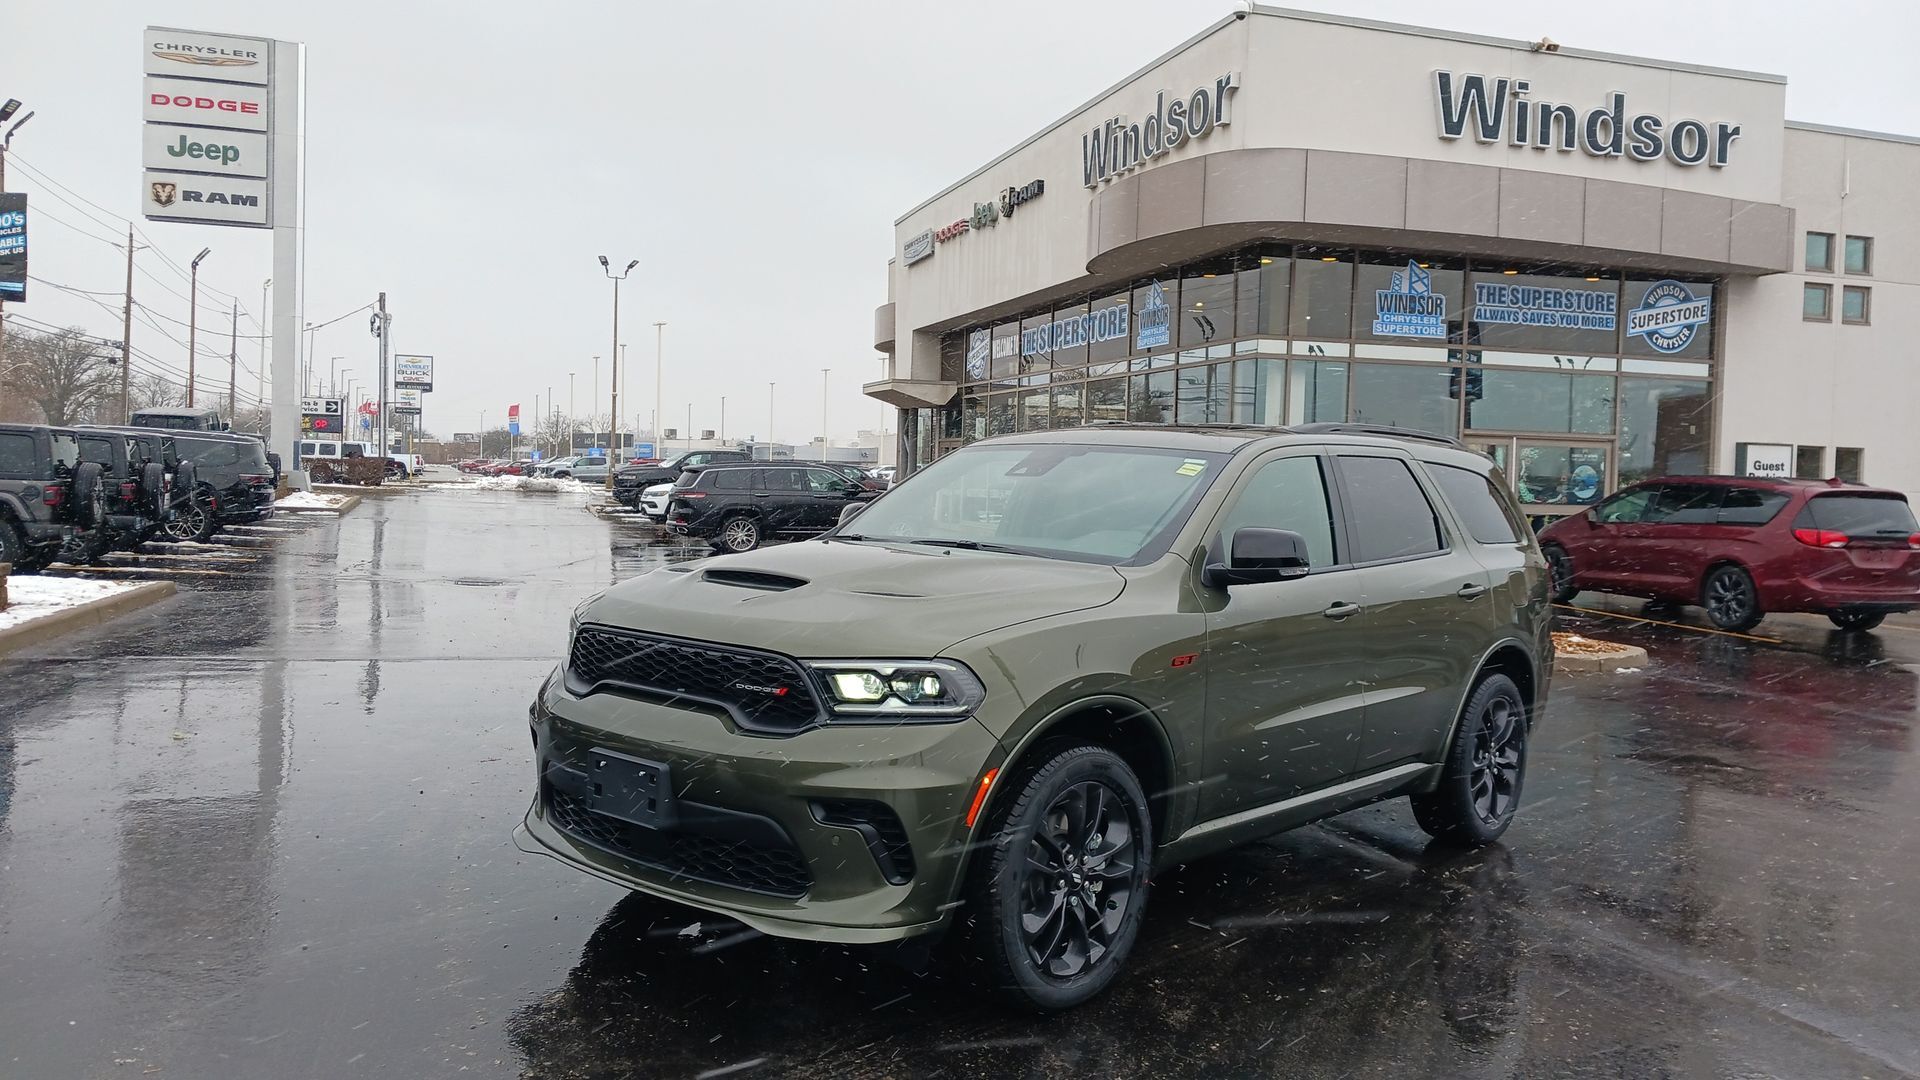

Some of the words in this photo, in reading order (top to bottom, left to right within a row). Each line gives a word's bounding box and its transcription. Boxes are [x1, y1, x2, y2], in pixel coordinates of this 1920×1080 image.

[153, 42, 258, 59] CHRYSLER
[151, 94, 259, 115] DODGE
[1431, 69, 1742, 168] Windsor
[1082, 72, 1240, 189] Windsor
[167, 134, 240, 166] Jeep
[182, 190, 258, 207] RAM
[1011, 180, 1045, 206] RAM
[970, 202, 1000, 230] Jeep
[903, 232, 930, 251] CHRYSLER
[935, 218, 970, 244] DODGE
[1377, 291, 1444, 316] WINDSOR
[1476, 285, 1507, 304] THE
[1509, 287, 1615, 313] SUPERSTORE
[1649, 285, 1686, 305] WINDSOR
[1383, 314, 1437, 325] CHRYSLER
[1475, 308, 1520, 323] ALWAYS
[1521, 310, 1557, 325] SAVES
[1559, 314, 1580, 328] YOU
[1581, 315, 1615, 329] MORE!
[1631, 304, 1707, 330] SUPERSTORE
[1022, 329, 1037, 355] THE
[1038, 304, 1128, 353] SUPERSTORE
[1376, 323, 1444, 335] SUPERSTORE
[1652, 327, 1691, 349] CHRYSLER
[397, 369, 430, 377] BUICK
[1753, 460, 1785, 472] Guest
[1170, 653, 1200, 668] GT
[735, 683, 780, 694] DODGE
